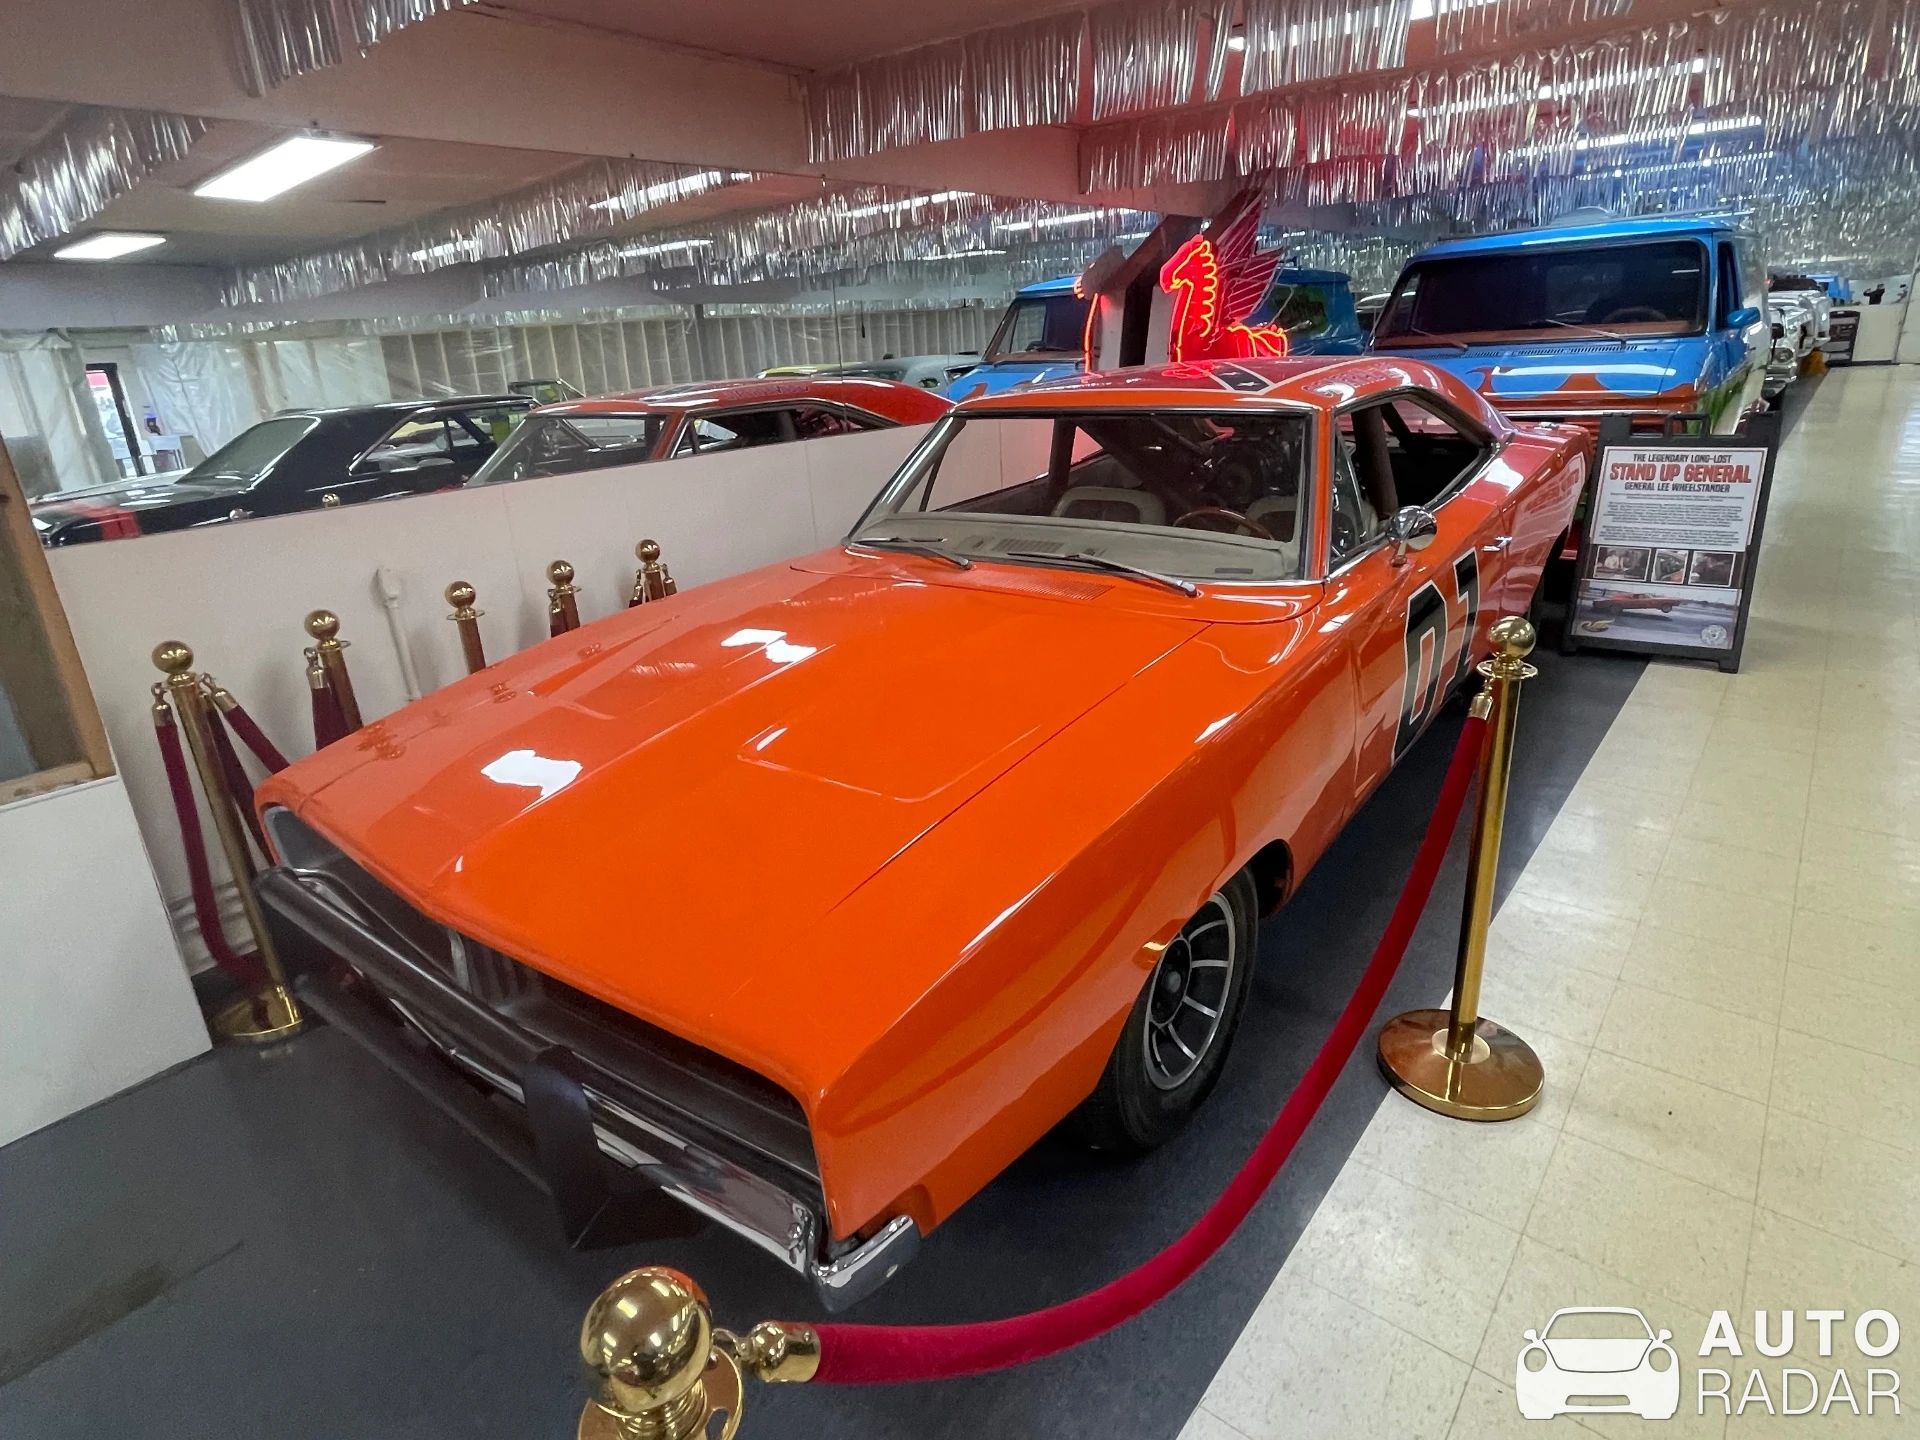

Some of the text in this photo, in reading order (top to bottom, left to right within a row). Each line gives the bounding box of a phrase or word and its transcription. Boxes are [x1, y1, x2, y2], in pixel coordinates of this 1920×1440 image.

[1633, 453, 1732, 464] THE LEGENDARY LONG-LOST
[1609, 462, 1752, 484] STAND UP GENERAL
[1624, 482, 1731, 493] GENERAL LEE WHEELSTANDER
[1391, 547, 1480, 767] 01
